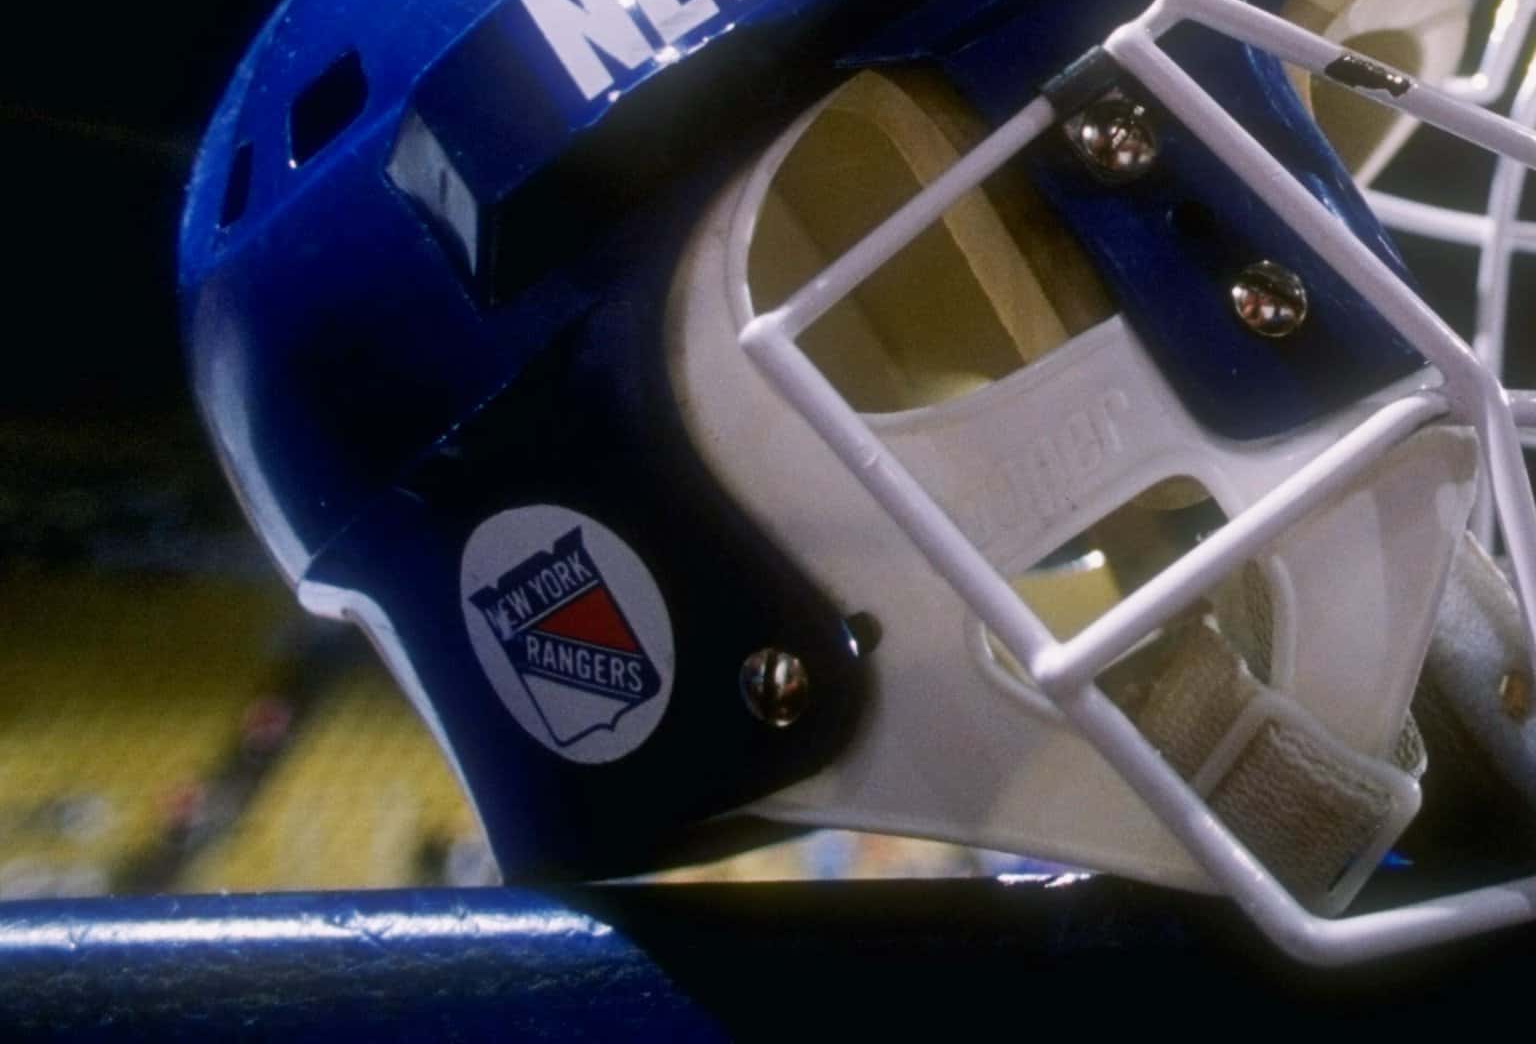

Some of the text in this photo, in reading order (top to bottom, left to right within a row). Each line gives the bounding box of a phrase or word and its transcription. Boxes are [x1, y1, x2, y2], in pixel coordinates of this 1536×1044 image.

[485, 551, 592, 641] NEW YORK
[526, 635, 644, 692] RANGERS
